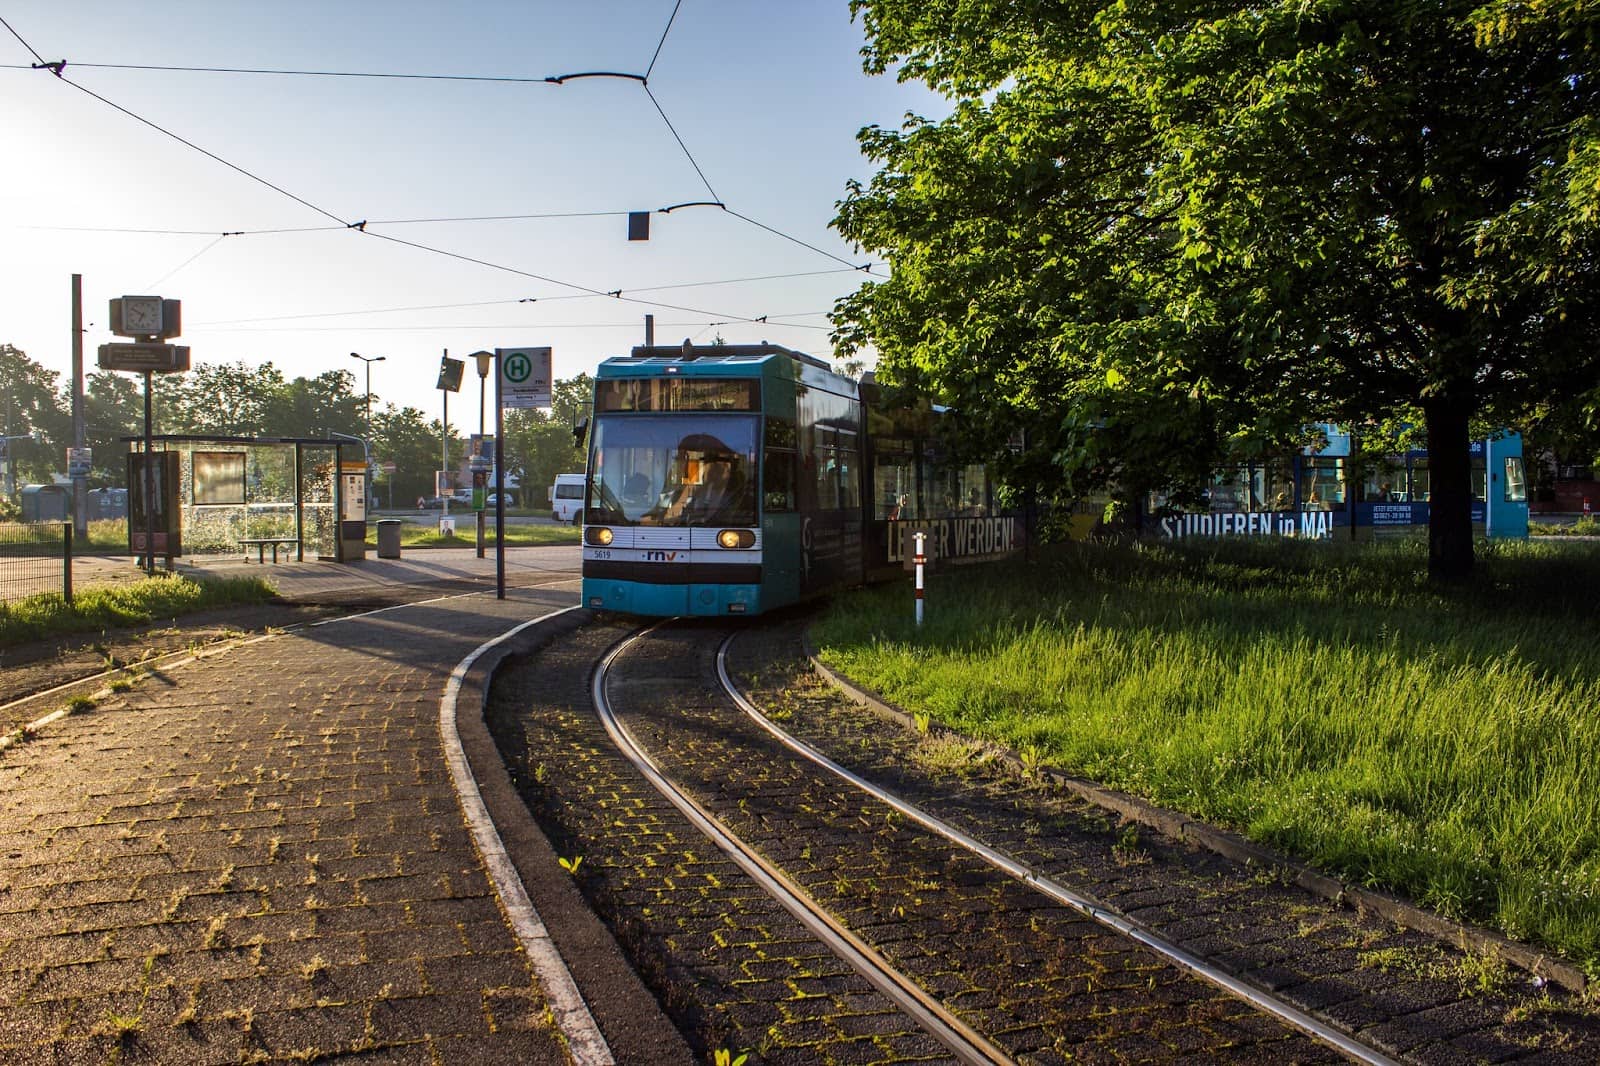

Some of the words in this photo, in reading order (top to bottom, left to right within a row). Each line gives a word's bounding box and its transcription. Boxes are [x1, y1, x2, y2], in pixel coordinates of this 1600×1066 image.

[511, 360, 524, 376] H
[1279, 514, 1295, 538] in
[1301, 511, 1333, 540] MA!
[954, 517, 1015, 556] WERDEN!
[594, 550, 611, 559] 5619
[647, 550, 677, 561] rnv
